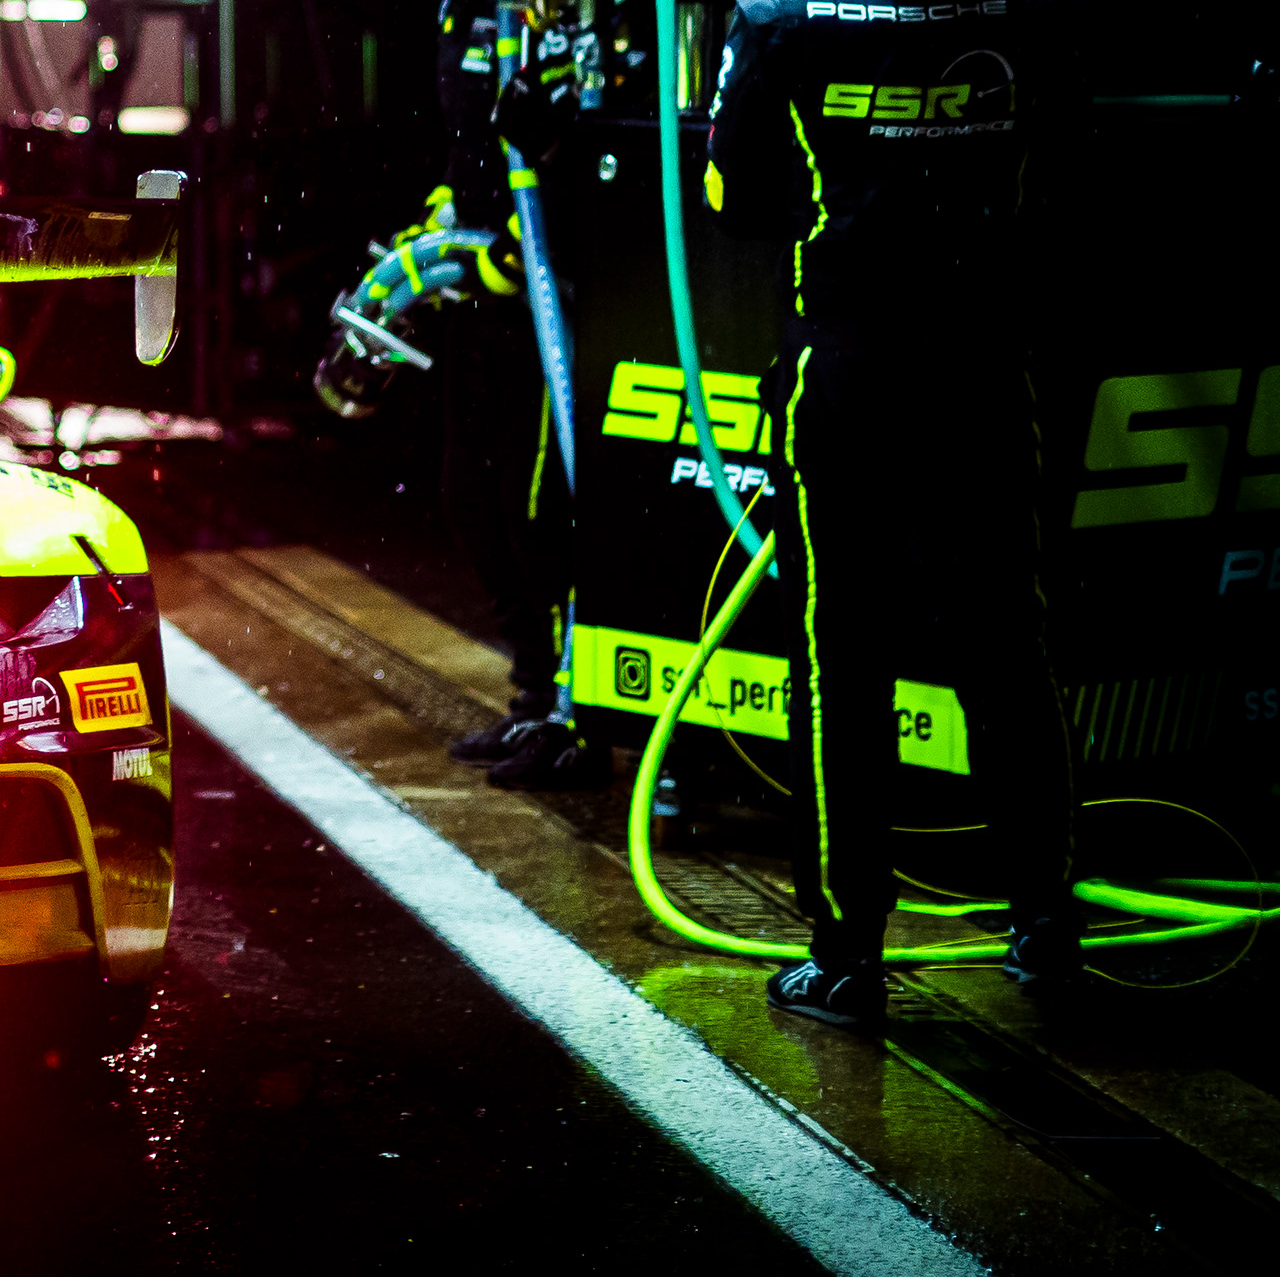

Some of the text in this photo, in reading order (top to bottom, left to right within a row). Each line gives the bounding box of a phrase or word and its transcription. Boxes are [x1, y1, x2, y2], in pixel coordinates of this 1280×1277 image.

[807, 0, 1008, 23] PORSCHE
[822, 82, 972, 120] SSR
[869, 120, 1015, 139] PERFORMANCE
[602, 360, 773, 455] SS
[2, 695, 46, 723] SSR
[74, 676, 143, 721] PIRELLI
[112, 747, 153, 781] MOTUL
